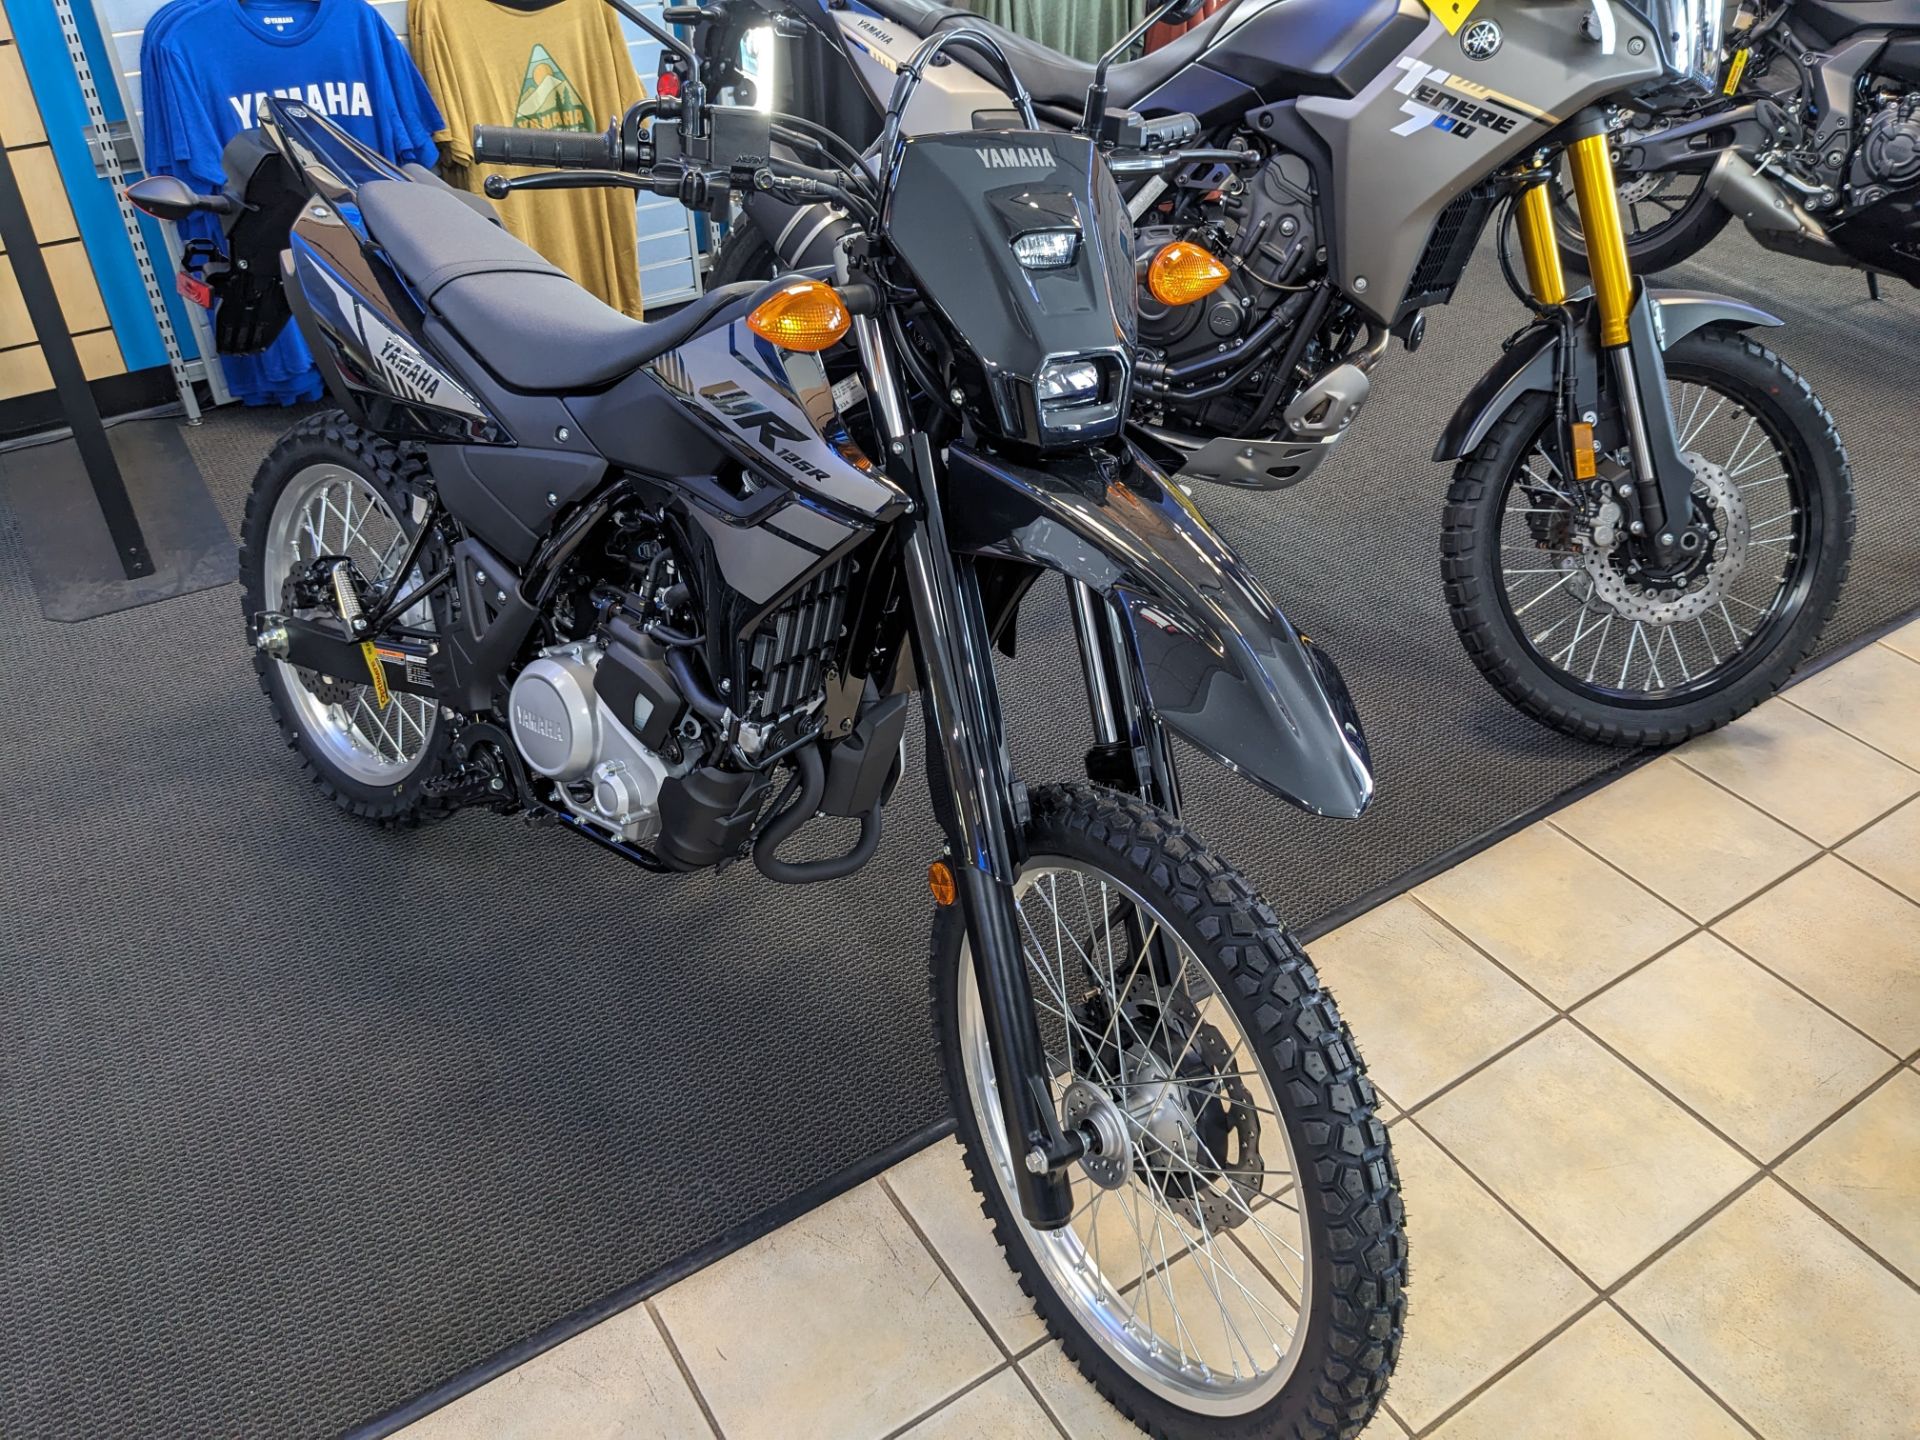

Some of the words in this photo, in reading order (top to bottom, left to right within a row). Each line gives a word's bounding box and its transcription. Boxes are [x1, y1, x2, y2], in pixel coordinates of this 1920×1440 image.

[857, 19, 894, 45] YAMAHA
[229, 81, 373, 130] YAHA
[1389, 99, 1478, 140] 700
[975, 147, 1057, 169] YAMAHA
[380, 338, 441, 399] YAMAHA
[775, 447, 832, 484] 125R
[516, 704, 564, 742] YAMAHA
